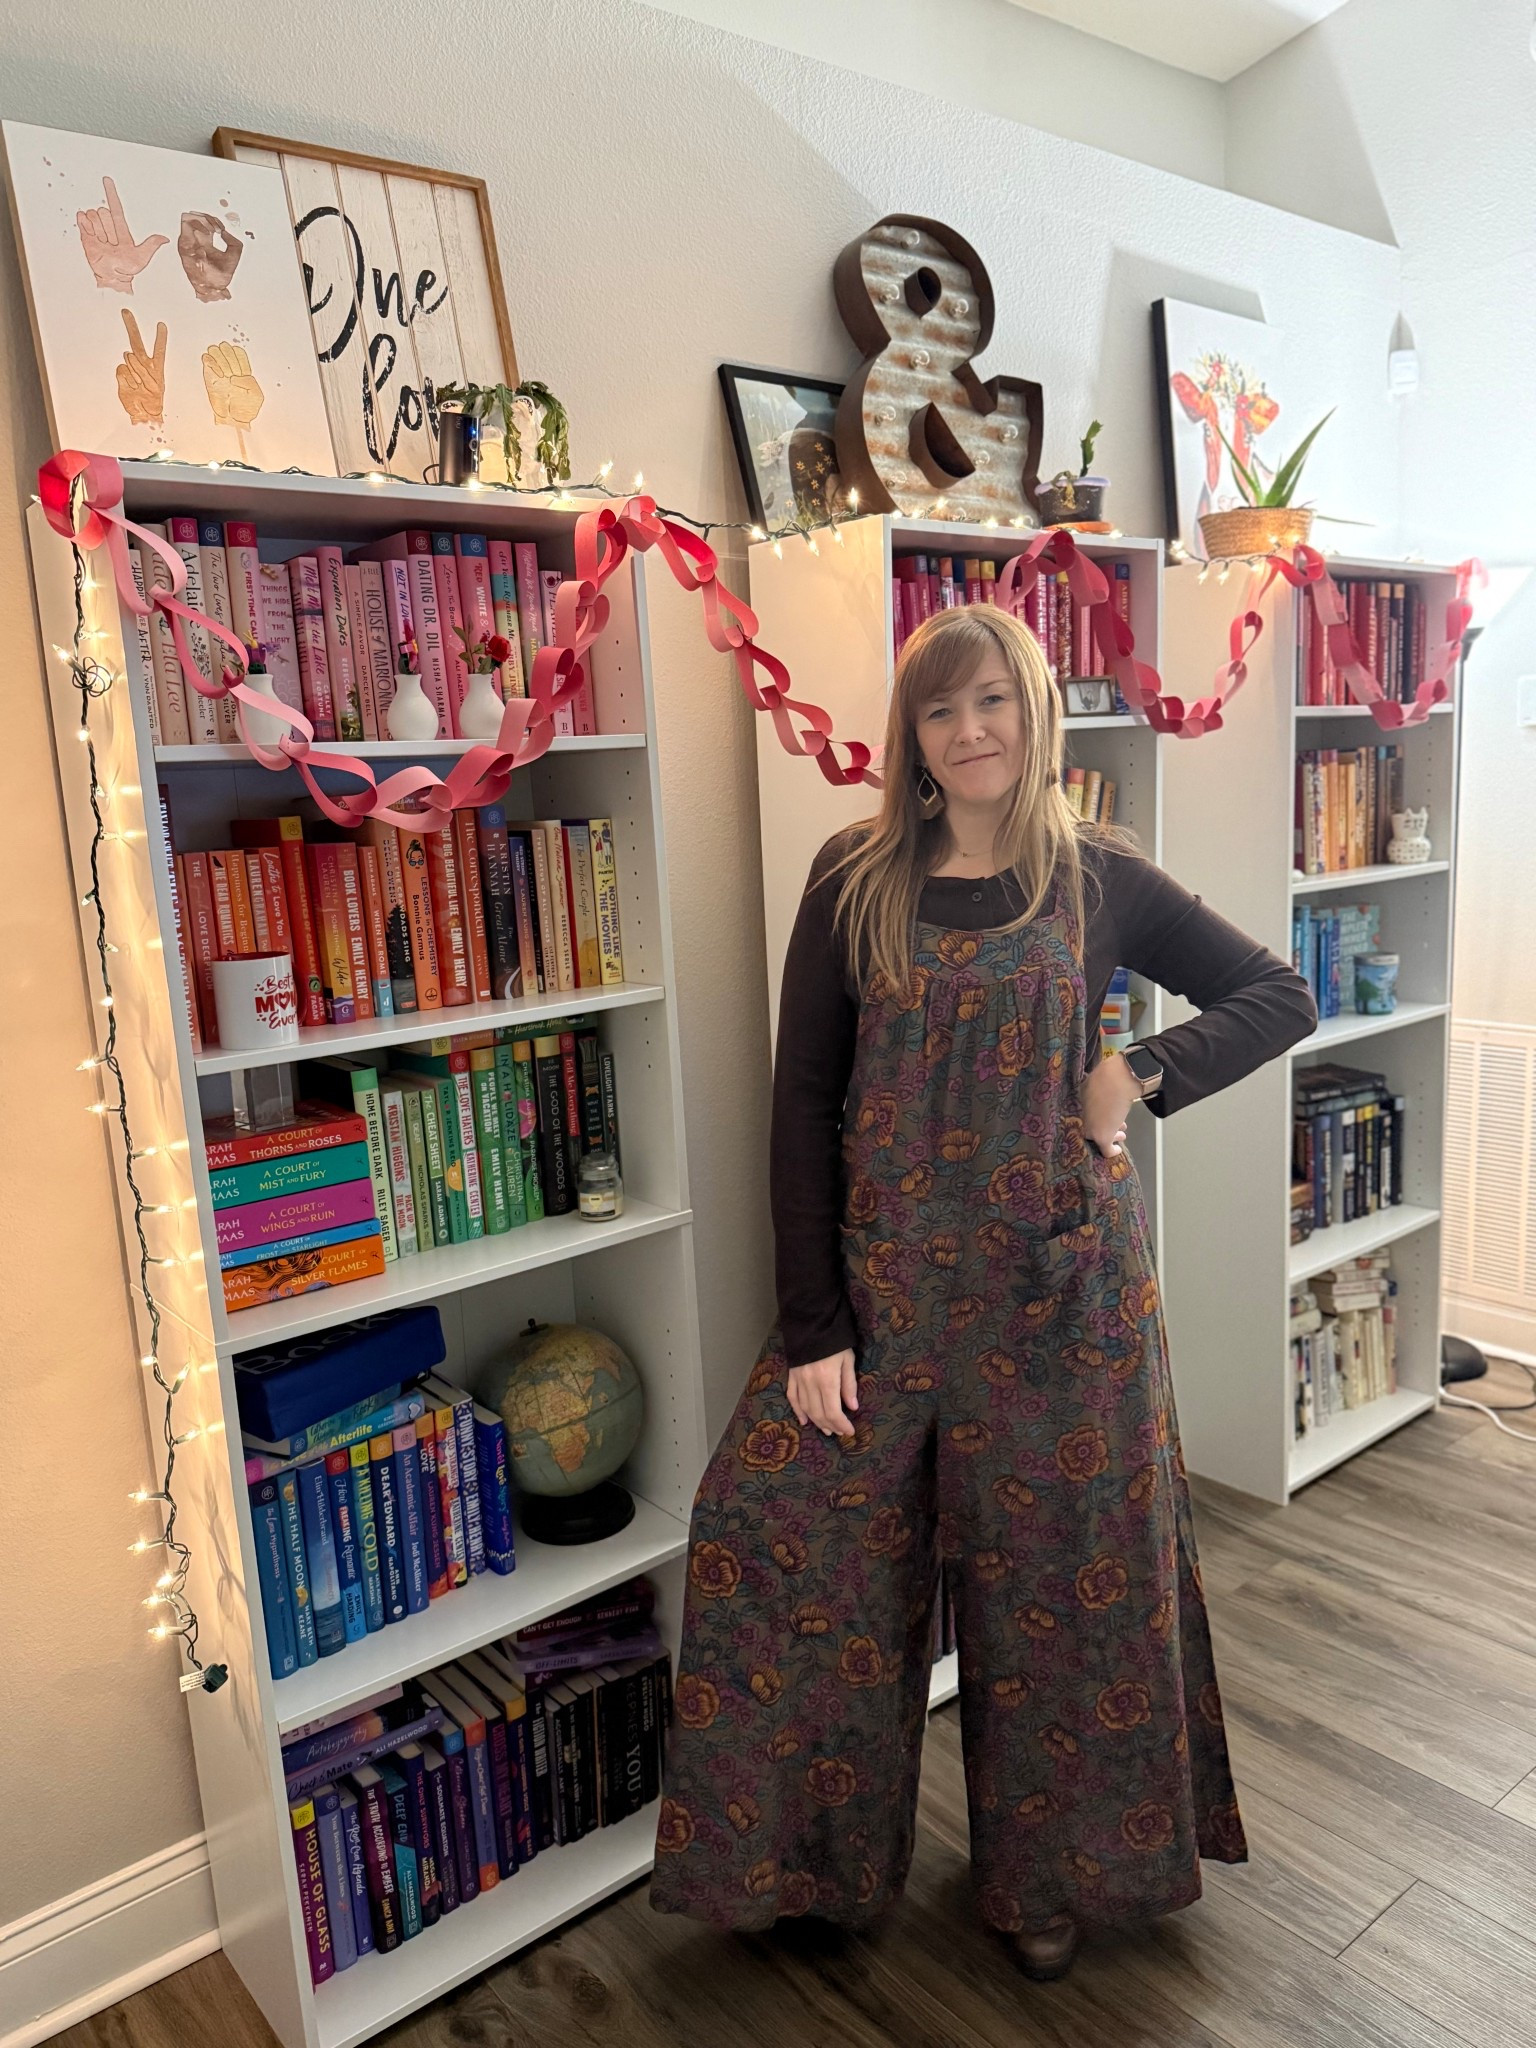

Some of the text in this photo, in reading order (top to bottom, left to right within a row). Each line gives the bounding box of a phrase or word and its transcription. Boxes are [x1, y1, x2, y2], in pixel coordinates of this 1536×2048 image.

[295, 206, 448, 364] One
[245, 571, 256, 617] FIRST-TIME
[261, 584, 288, 592] THINGS
[394, 567, 406, 586] NOT
[474, 562, 488, 618] RED WHITE
[262, 597, 291, 605] WE HIDE
[267, 610, 286, 618] FROM
[328, 557, 349, 647] Expiration Dates
[366, 590, 384, 633] HOUSE
[418, 560, 440, 652] DATING DR. DIL
[270, 636, 291, 644] LIGHT
[271, 623, 285, 632] THE
[162, 643, 181, 713] Ela Lee
[312, 645, 327, 675] Lake
[316, 681, 325, 718] FORTUNE
[322, 684, 331, 714] CARLEY
[435, 686, 446, 720] SHARMA
[232, 854, 244, 901] Happiness
[327, 856, 339, 904] CHRISTINA
[487, 843, 500, 897] HANNAH
[499, 843, 512, 896] KRISTIN
[193, 860, 202, 878] THE
[198, 911, 209, 936] LOVE
[263, 852, 285, 937] Loathe Love You
[468, 846, 485, 937] Correspondent
[220, 904, 235, 946] ROMANTICS
[343, 869, 369, 1000] BOOK LOVERS EMILY HENRY
[412, 894, 425, 961] Bonnie Garmus
[421, 876, 438, 977] LESSONS CHEMISTRY
[442, 842, 468, 989] BIG BEAUTIFUL LIFE EMILY HENRY
[598, 891, 612, 955] THE MOVIES
[608, 885, 621, 959] NOTHING LIKE
[373, 910, 387, 976] WHEN ROME
[402, 940, 411, 963] SING
[262, 972, 292, 994] Best
[269, 1009, 297, 1029] Ever
[310, 996, 319, 1020] FAGAN
[488, 1072, 498, 1101] PEOPLE
[603, 1057, 613, 1098] LOVELIGHT
[412, 1122, 421, 1143] DEAR
[462, 1117, 474, 1146] HATERS
[482, 1093, 492, 1133] VACATION
[250, 1134, 342, 1159] THORNS ROSES
[278, 1127, 315, 1143] COURT
[365, 1093, 384, 1179] HOME BEFORE DARK
[387, 1104, 405, 1183] KRISTAN HIGGINS
[426, 1112, 441, 1170] CHEAT SHEET
[550, 1090, 566, 1192] GOD WOODS
[259, 1170, 327, 1192] MIST FURY
[275, 1161, 311, 1177] COURT
[464, 1152, 480, 1217] KATHERINE CENTER
[490, 1147, 505, 1212] EMILY HENRY
[505, 1158, 516, 1197] LAUREN
[513, 1150, 524, 1203] CHRISTINA
[260, 1209, 336, 1234] WINGS RUIN
[280, 1202, 316, 1218] COURT
[376, 1188, 391, 1242] RILEY SAGER
[437, 1204, 446, 1227] ADAMS
[256, 1240, 328, 1260] FROST STARLIGHT
[280, 1236, 304, 1248] COURT
[321, 1249, 356, 1265] COURT
[290, 1259, 369, 1287] SILVER FLAMES
[330, 1424, 373, 1448] Afterlife
[459, 1412, 477, 1484] FUNNY STORY
[419, 1448, 429, 1473] LOVE
[427, 1441, 437, 1474] LUNAR
[448, 1452, 459, 1488] STRANGER
[316, 1493, 329, 1546] Hilderbrand
[380, 1466, 396, 1548] DEAR EDWARD
[404, 1467, 417, 1537] Academic Affair
[338, 1505, 353, 1542] FREAKING
[358, 1479, 380, 1573] KILLING COLD
[465, 1493, 484, 1558] EMILY HENRY
[286, 1500, 305, 1589] THE HALF MOON
[388, 1556, 398, 1601] NAPOLITANO
[298, 1614, 308, 1640] KEANE
[556, 1616, 582, 1628] ENOUGH
[535, 1656, 578, 1669] OFF-LIMITS
[306, 1727, 369, 1762] Autoboyography
[387, 1724, 428, 1749] HAZELWOOD
[533, 1716, 548, 1778] FICTION WRITER
[326, 1761, 353, 1778] Mate
[627, 1744, 641, 1792] YOU
[393, 1794, 409, 1843] DEEP END
[420, 1809, 431, 1849] SURVIVORS
[436, 1784, 449, 1857] SOULMATE EQUATION
[368, 1801, 395, 1895] TRUTH ACCORDING EMBER
[306, 1828, 330, 1954] HOUSE OF GLASS
[352, 1863, 367, 1897] Agenda
[421, 1856, 431, 1892] MIRANDA
[302, 1889, 313, 1933] PEKKANEN
[408, 1881, 417, 1920] HAZELWOOD
